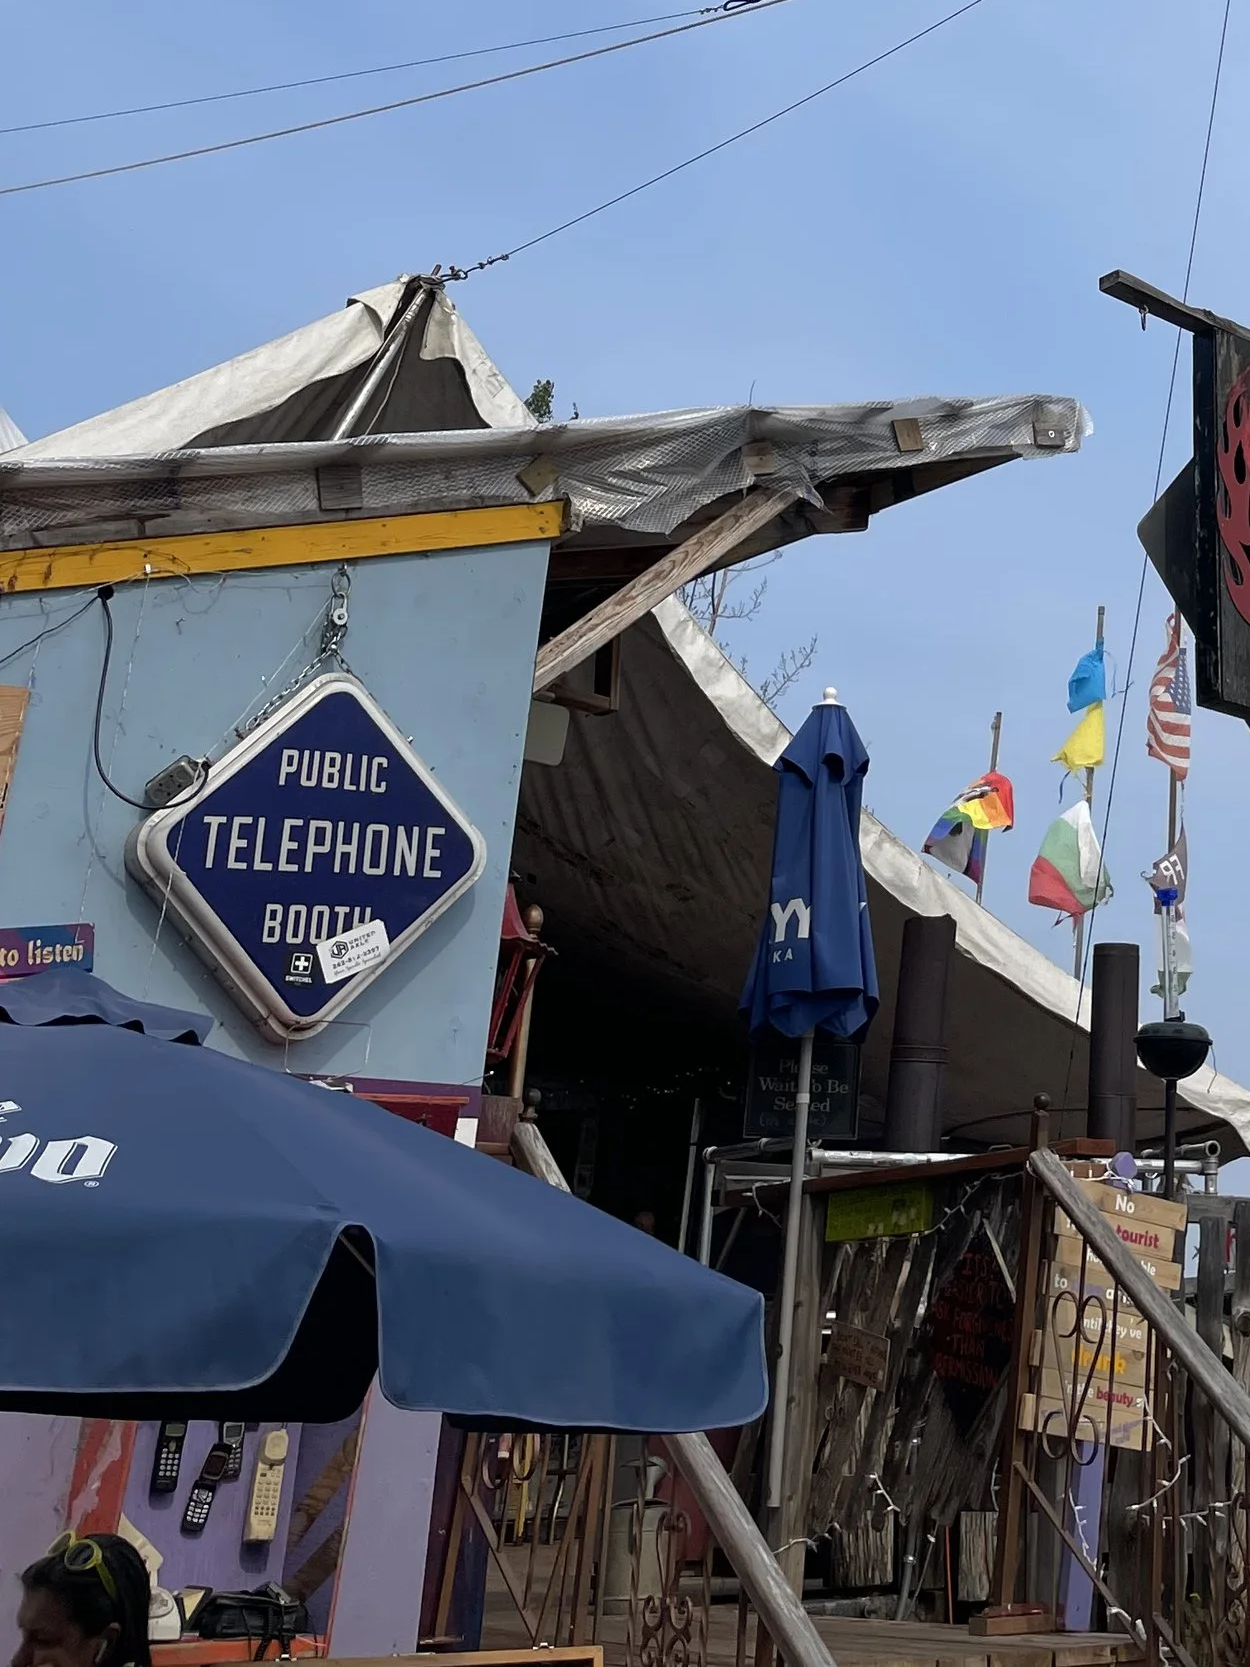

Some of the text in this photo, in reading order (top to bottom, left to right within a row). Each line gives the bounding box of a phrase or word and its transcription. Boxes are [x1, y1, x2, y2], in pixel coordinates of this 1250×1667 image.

[278, 748, 389, 794] PUBLIC
[203, 815, 446, 879] TELEPHONE
[27, 939, 84, 966] listen
[779, 1058, 829, 1075] Plse
[827, 1078, 849, 1095] Be
[773, 1095, 831, 1113] Seed
[1115, 1193, 1136, 1214] No
[1115, 1224, 1160, 1250] tourist
[1054, 1273, 1068, 1290] to
[1083, 1317, 1102, 1332] ntil
